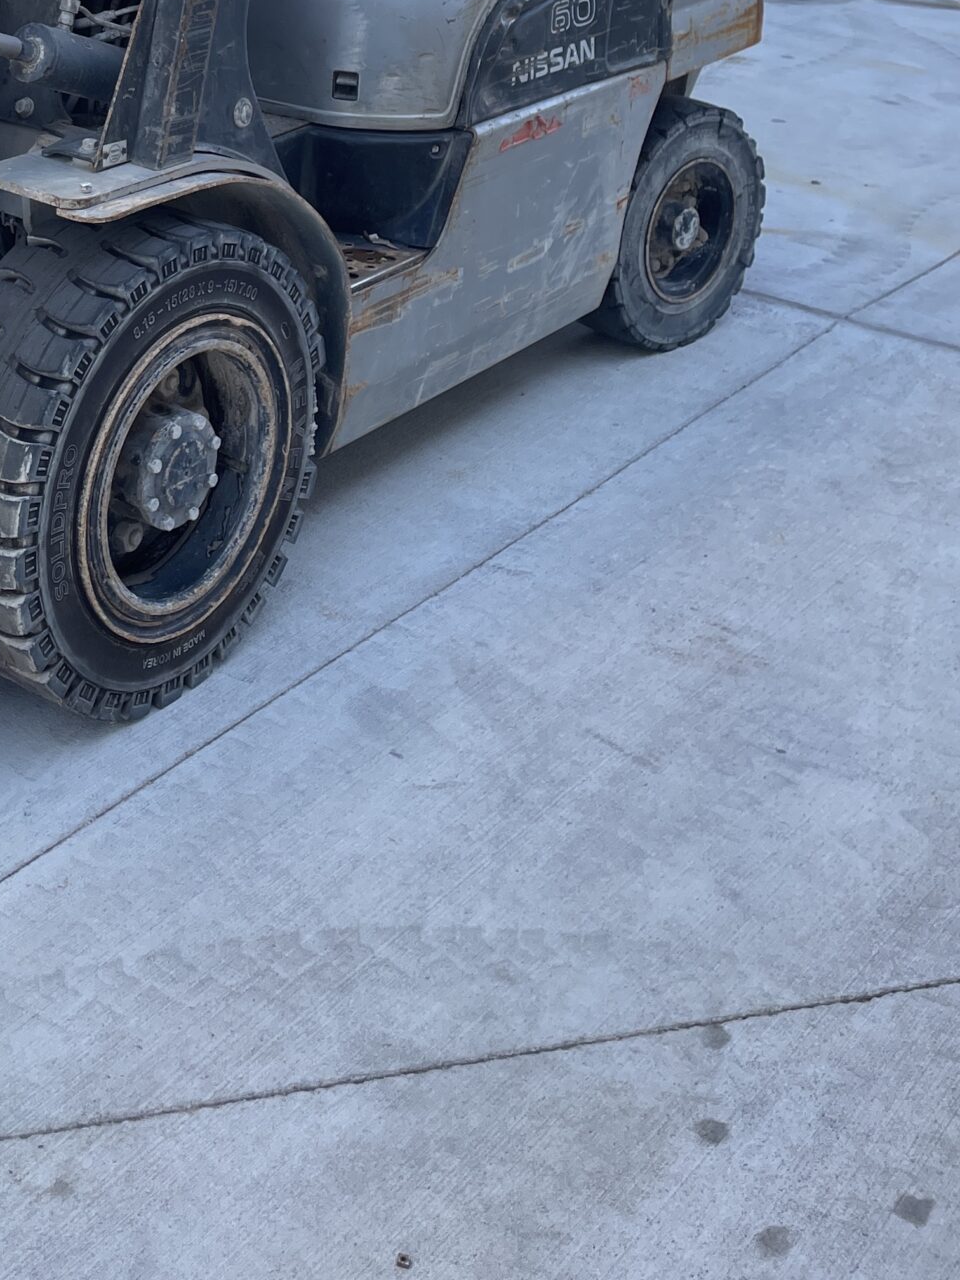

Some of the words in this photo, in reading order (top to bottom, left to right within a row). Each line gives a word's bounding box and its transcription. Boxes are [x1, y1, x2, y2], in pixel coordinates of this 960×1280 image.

[511, 36, 595, 86] NISSAN
[50, 443, 79, 601] SOLIDPRO
[183, 629, 206, 650] MADE
[142, 652, 171, 670] KOREA
[172, 646, 182, 659] IN
